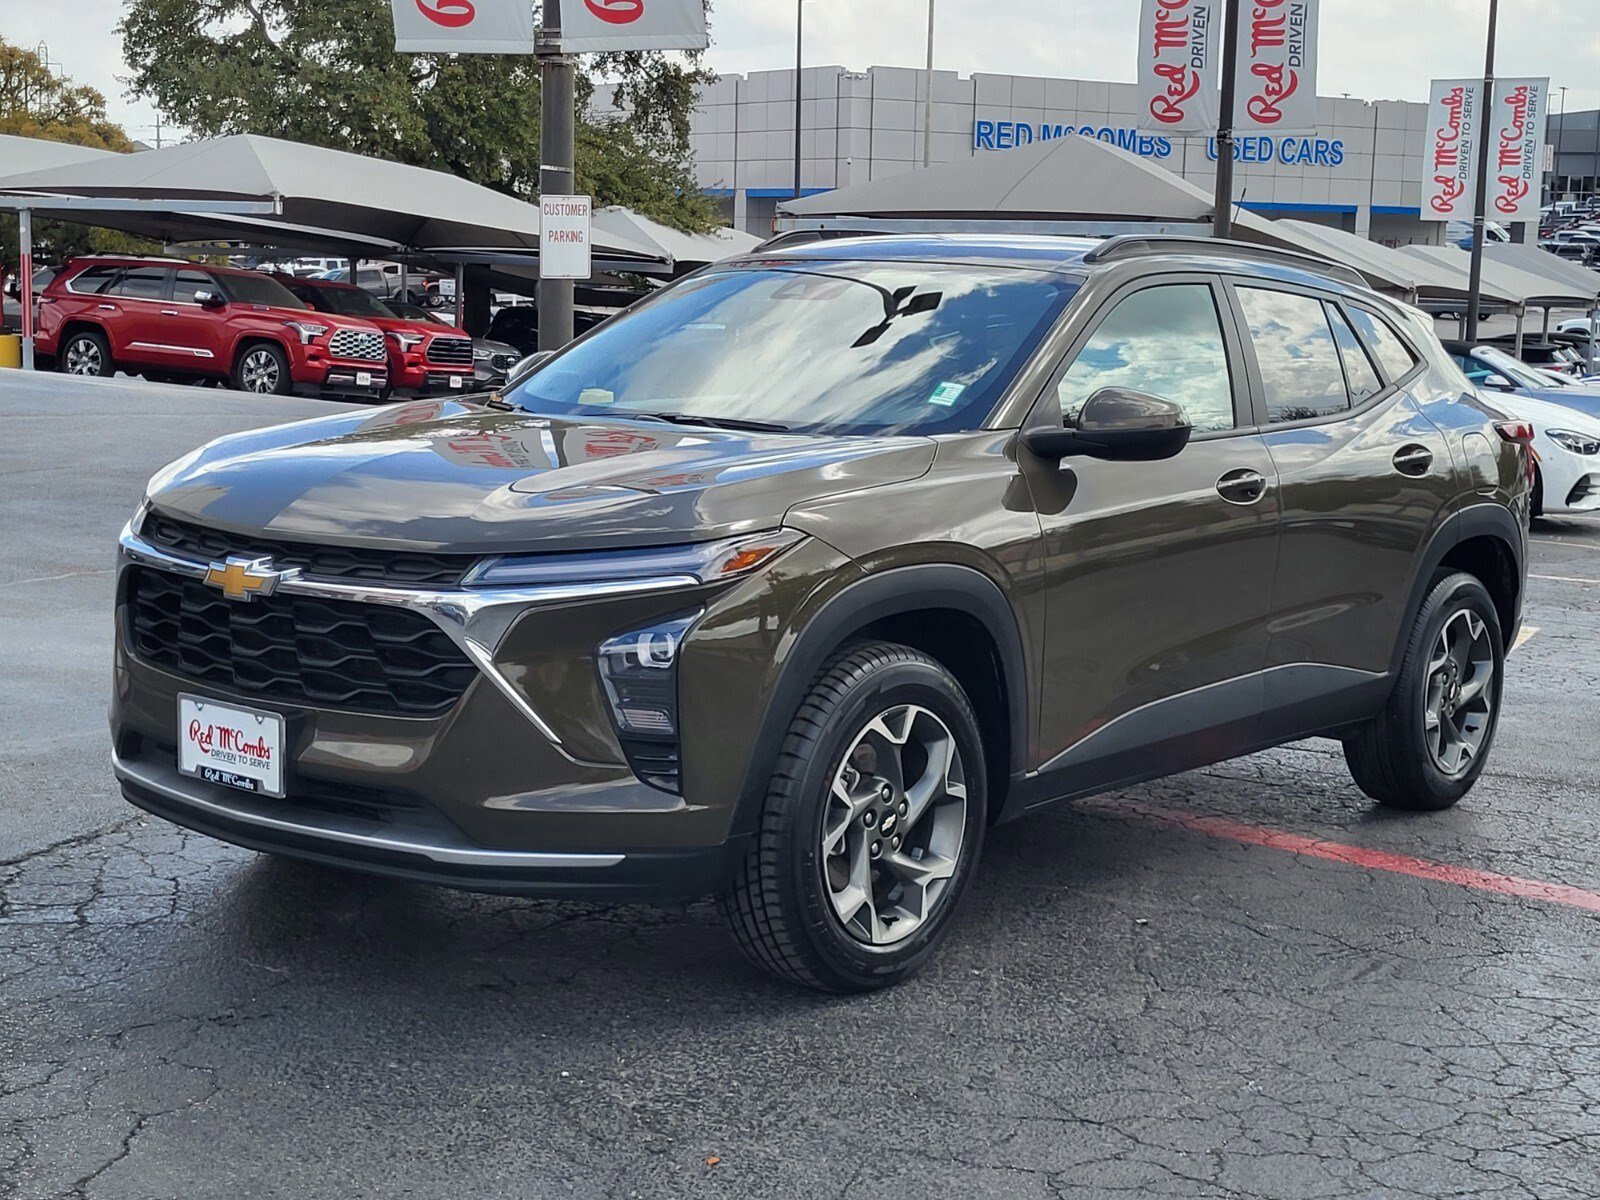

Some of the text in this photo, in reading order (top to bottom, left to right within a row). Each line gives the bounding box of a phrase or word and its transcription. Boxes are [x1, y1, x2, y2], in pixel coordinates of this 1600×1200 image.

[1190, 5, 1206, 69] DRIVEN
[1288, 3, 1303, 68] DRIVEN
[1150, 63, 1200, 123] Red
[1247, 63, 1298, 123] Red
[976, 120, 1034, 149] RED
[1280, 137, 1344, 166] CARS
[1430, 86, 1465, 213] Red McCombs
[1458, 86, 1474, 180] DRIVEN TO SERVE
[1495, 85, 1529, 213] Red McCombs
[1522, 85, 1539, 179] DRIVEN TO SERVE
[543, 203, 588, 216] CUSTOMER
[548, 230, 583, 243] PARKING
[189, 719, 271, 760] Red McCombs
[211, 749, 271, 770] DRIVEN TO SERVE
